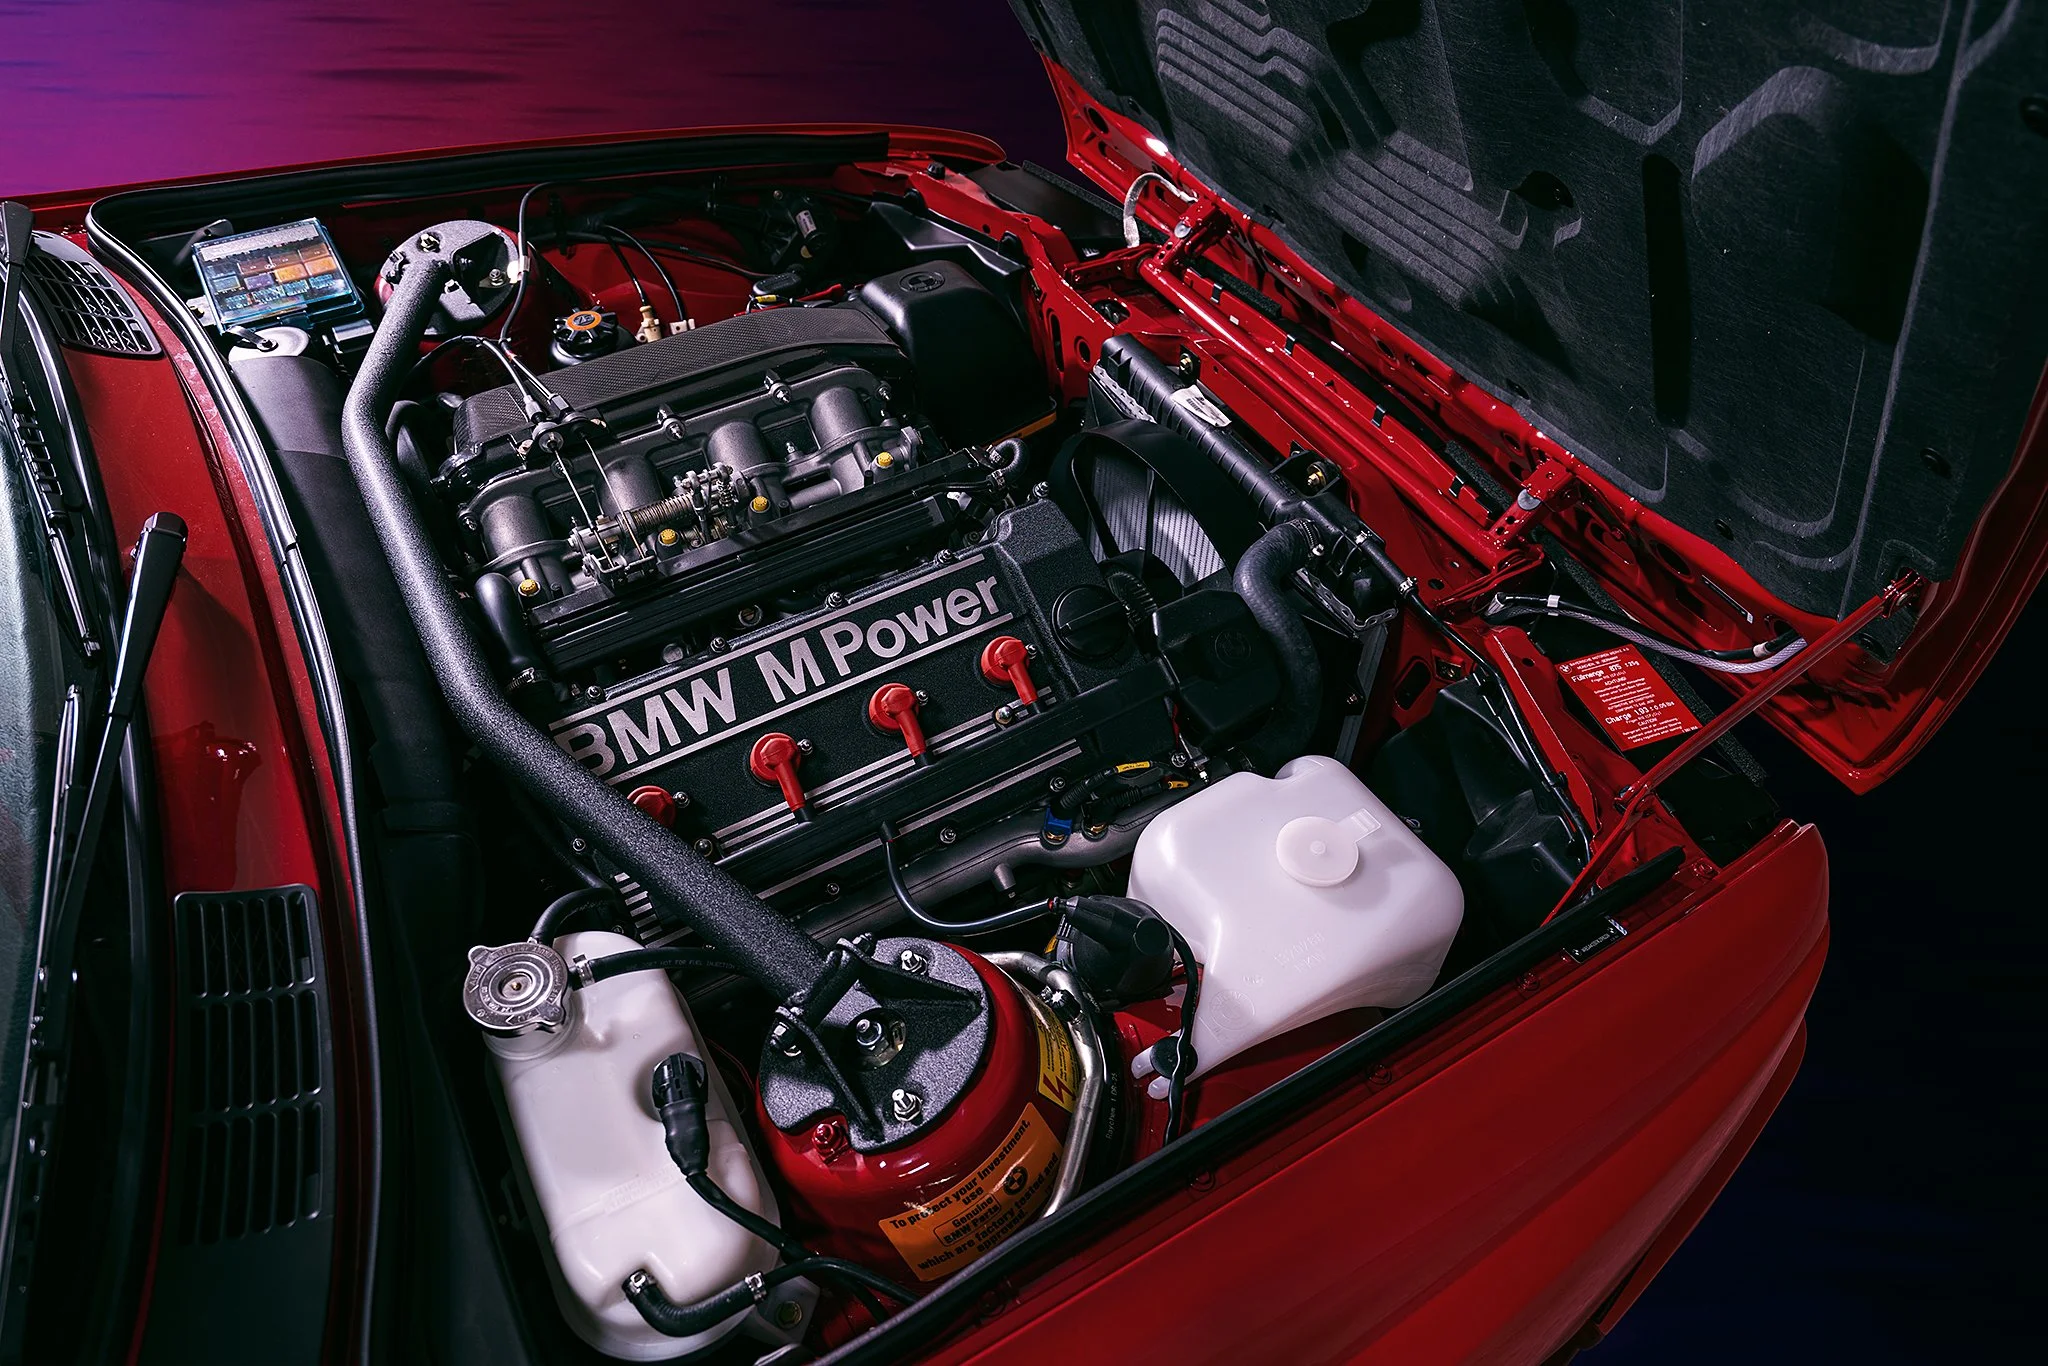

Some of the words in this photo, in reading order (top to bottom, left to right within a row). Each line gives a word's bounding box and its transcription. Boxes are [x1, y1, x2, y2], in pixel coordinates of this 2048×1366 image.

[1608, 663, 1622, 671] 875
[554, 670, 736, 776] BMW
[1605, 713, 1631, 724] Charge
[889, 1219, 905, 1229] To
[907, 1197, 953, 1226] protect
[952, 1177, 979, 1204] your
[917, 1251, 955, 1270] which
[954, 1238, 976, 1254] are
[975, 1207, 1016, 1242] factory
[1014, 1174, 1048, 1208] tested
[1045, 1152, 1060, 1176] and
[952, 1196, 995, 1228] Genuine
[962, 1187, 984, 1206] use
[943, 1225, 972, 1245] BMW
[972, 1204, 1001, 1227] Parts
